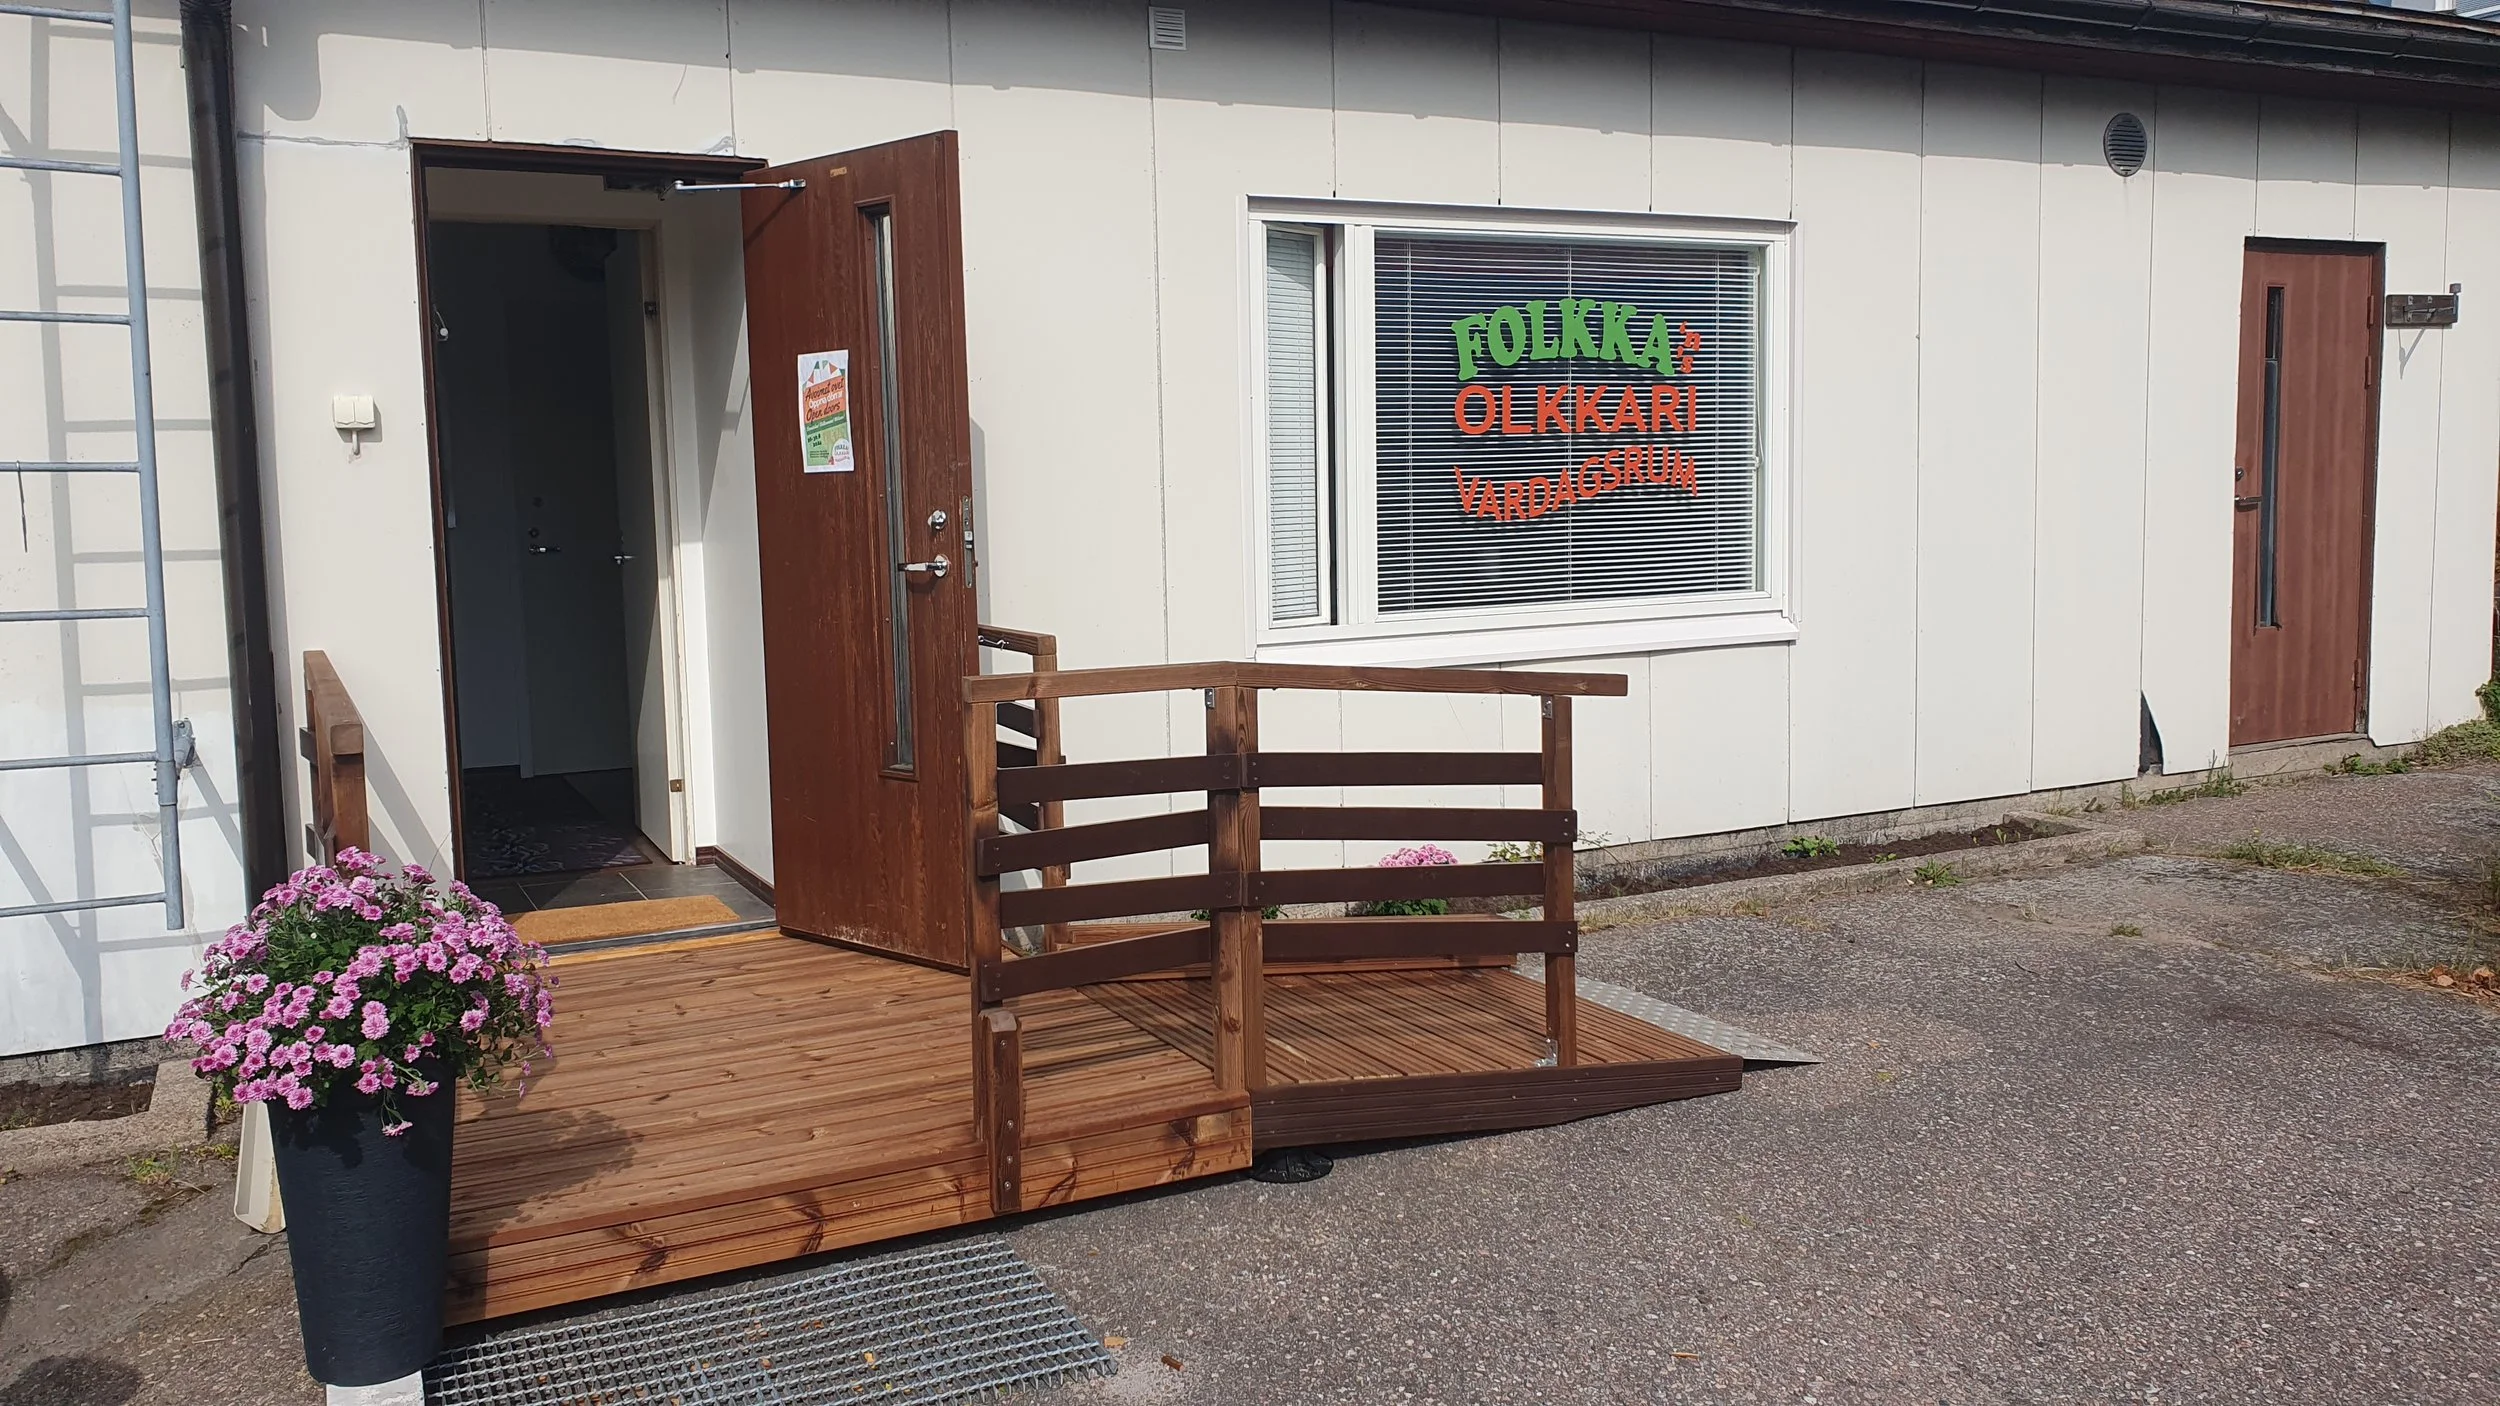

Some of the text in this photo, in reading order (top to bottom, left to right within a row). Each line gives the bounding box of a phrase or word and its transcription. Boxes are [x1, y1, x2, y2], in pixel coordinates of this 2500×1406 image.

[1451, 298, 1675, 381] FOLKKA
[806, 407, 823, 424] Open
[1454, 384, 1697, 434] OLKKARI
[1453, 444, 1698, 522] VARDAGSRUM
